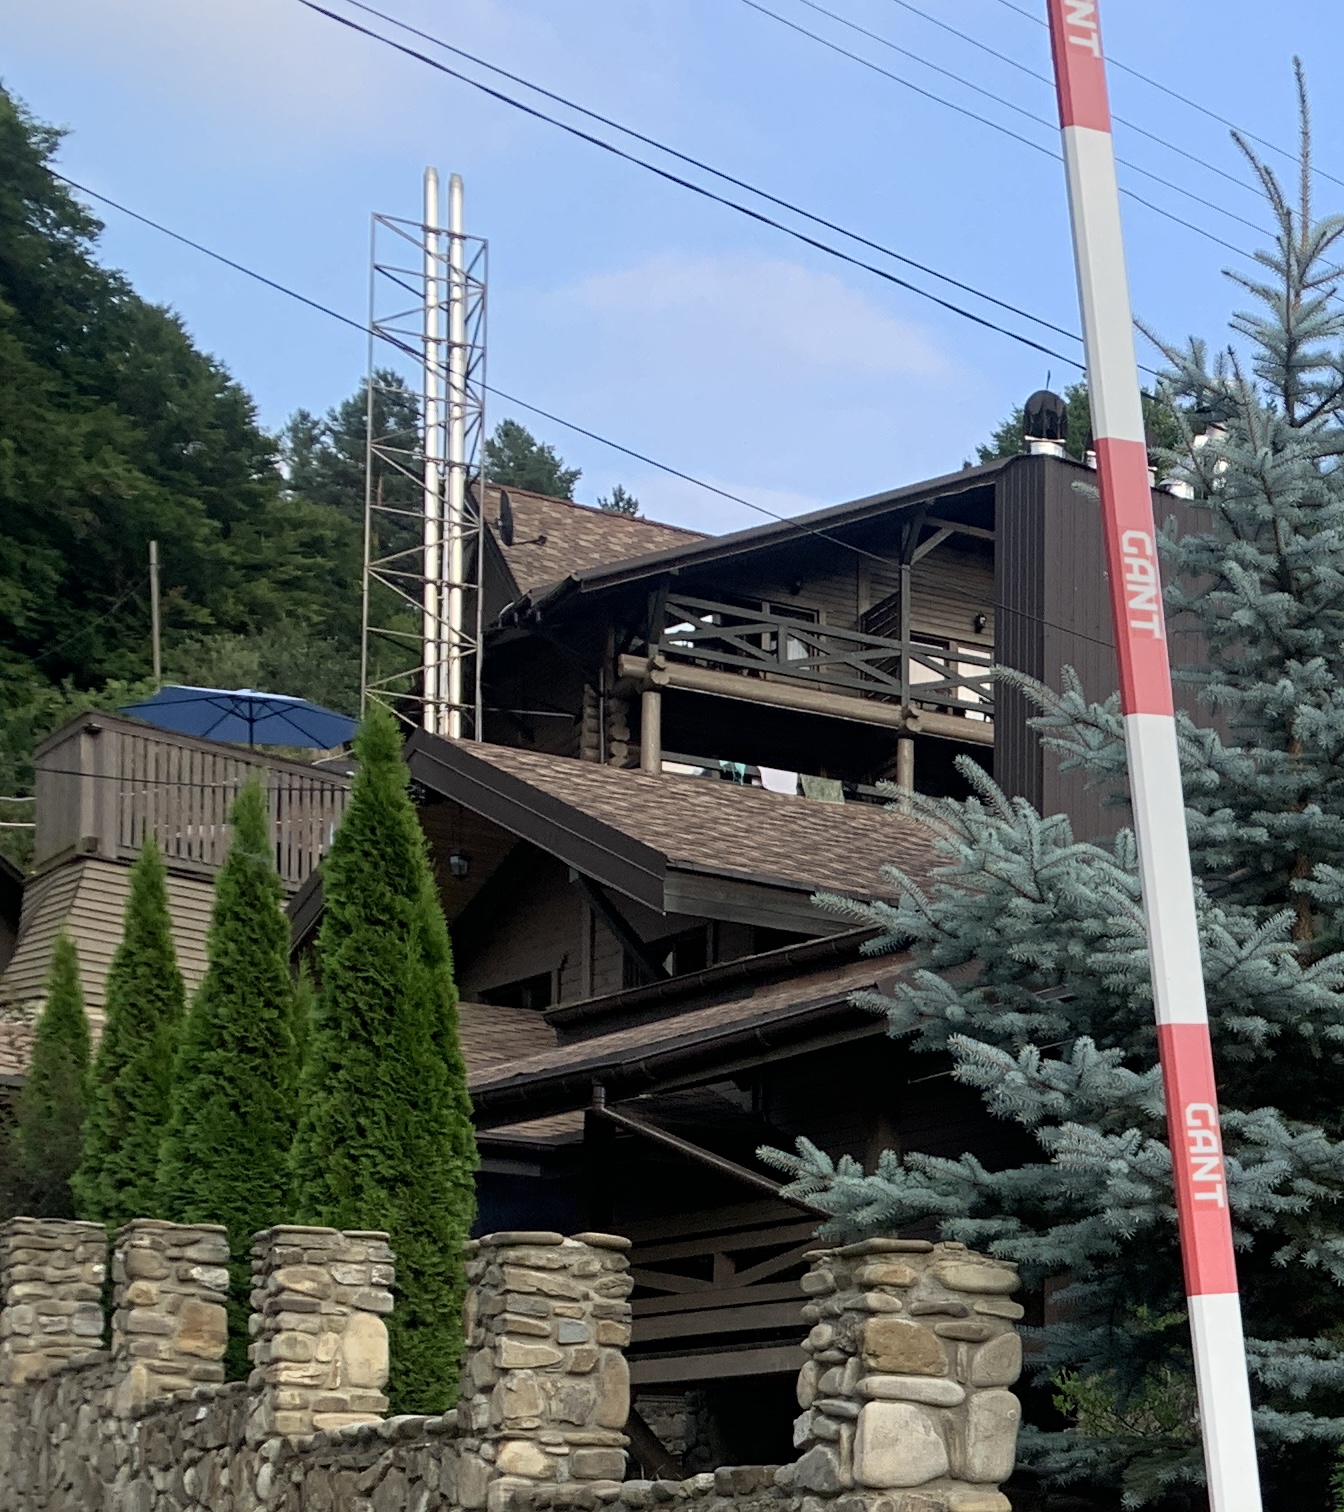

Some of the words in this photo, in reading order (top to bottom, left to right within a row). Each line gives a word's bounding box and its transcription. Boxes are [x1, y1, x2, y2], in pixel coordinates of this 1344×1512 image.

[1063, 0, 1101, 58] NT
[1120, 529, 1163, 640] GANT
[1185, 1102, 1225, 1209] GANT
